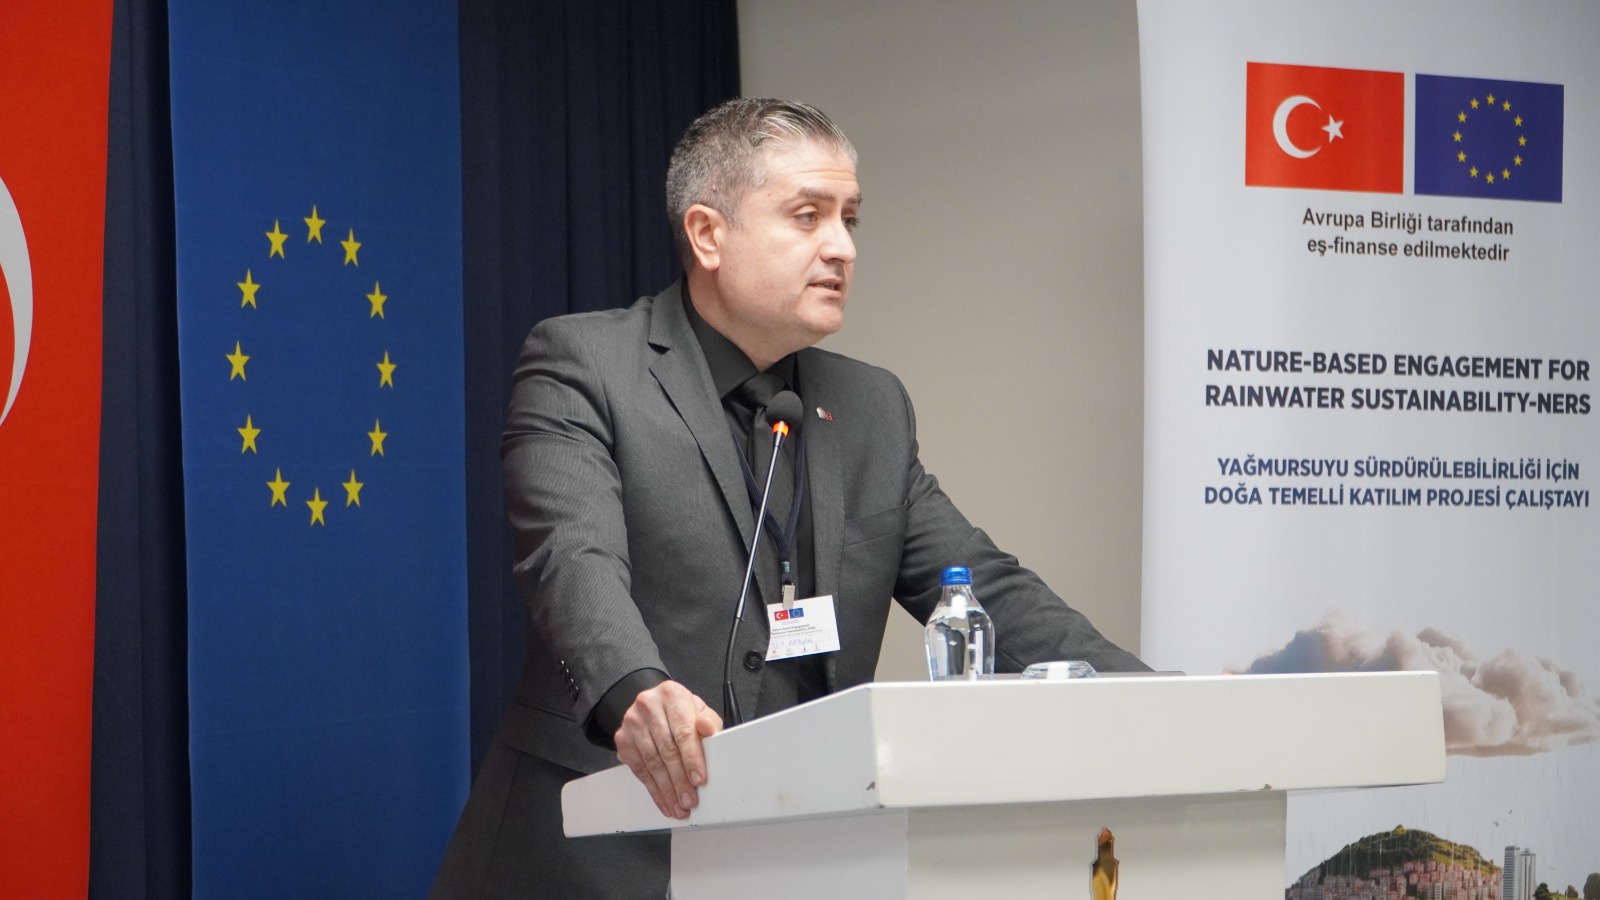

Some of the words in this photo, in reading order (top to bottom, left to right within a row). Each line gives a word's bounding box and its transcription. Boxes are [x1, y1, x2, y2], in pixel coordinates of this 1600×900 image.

[1303, 208, 1364, 231] Avrupa
[1371, 211, 1421, 235] Birliği
[1427, 213, 1513, 235] tarafından
[1308, 236, 1398, 257] eş-finanse
[1404, 240, 1509, 261] edilmektedir
[1208, 349, 1387, 375] NATURE-BASED
[1394, 354, 1543, 379] ENGAGEMENT
[1549, 359, 1589, 381] FOR
[1206, 385, 1345, 409] RAINWATER
[1351, 388, 1591, 415] SUSTAINABILITY-NERS
[1217, 454, 1348, 477] YAĞMURSUYU
[1354, 456, 1541, 479] SÜRDÜRÜLEBİLİRLİĞİ
[1547, 458, 1579, 483] İÇİN
[1205, 483, 1262, 505] DOĞA
[1269, 484, 1344, 505] TEMELLİ
[1350, 488, 1421, 506] KATILIM
[1427, 486, 1500, 507] PROJESİ
[1506, 489, 1589, 510] ÇALIŞTAYI
